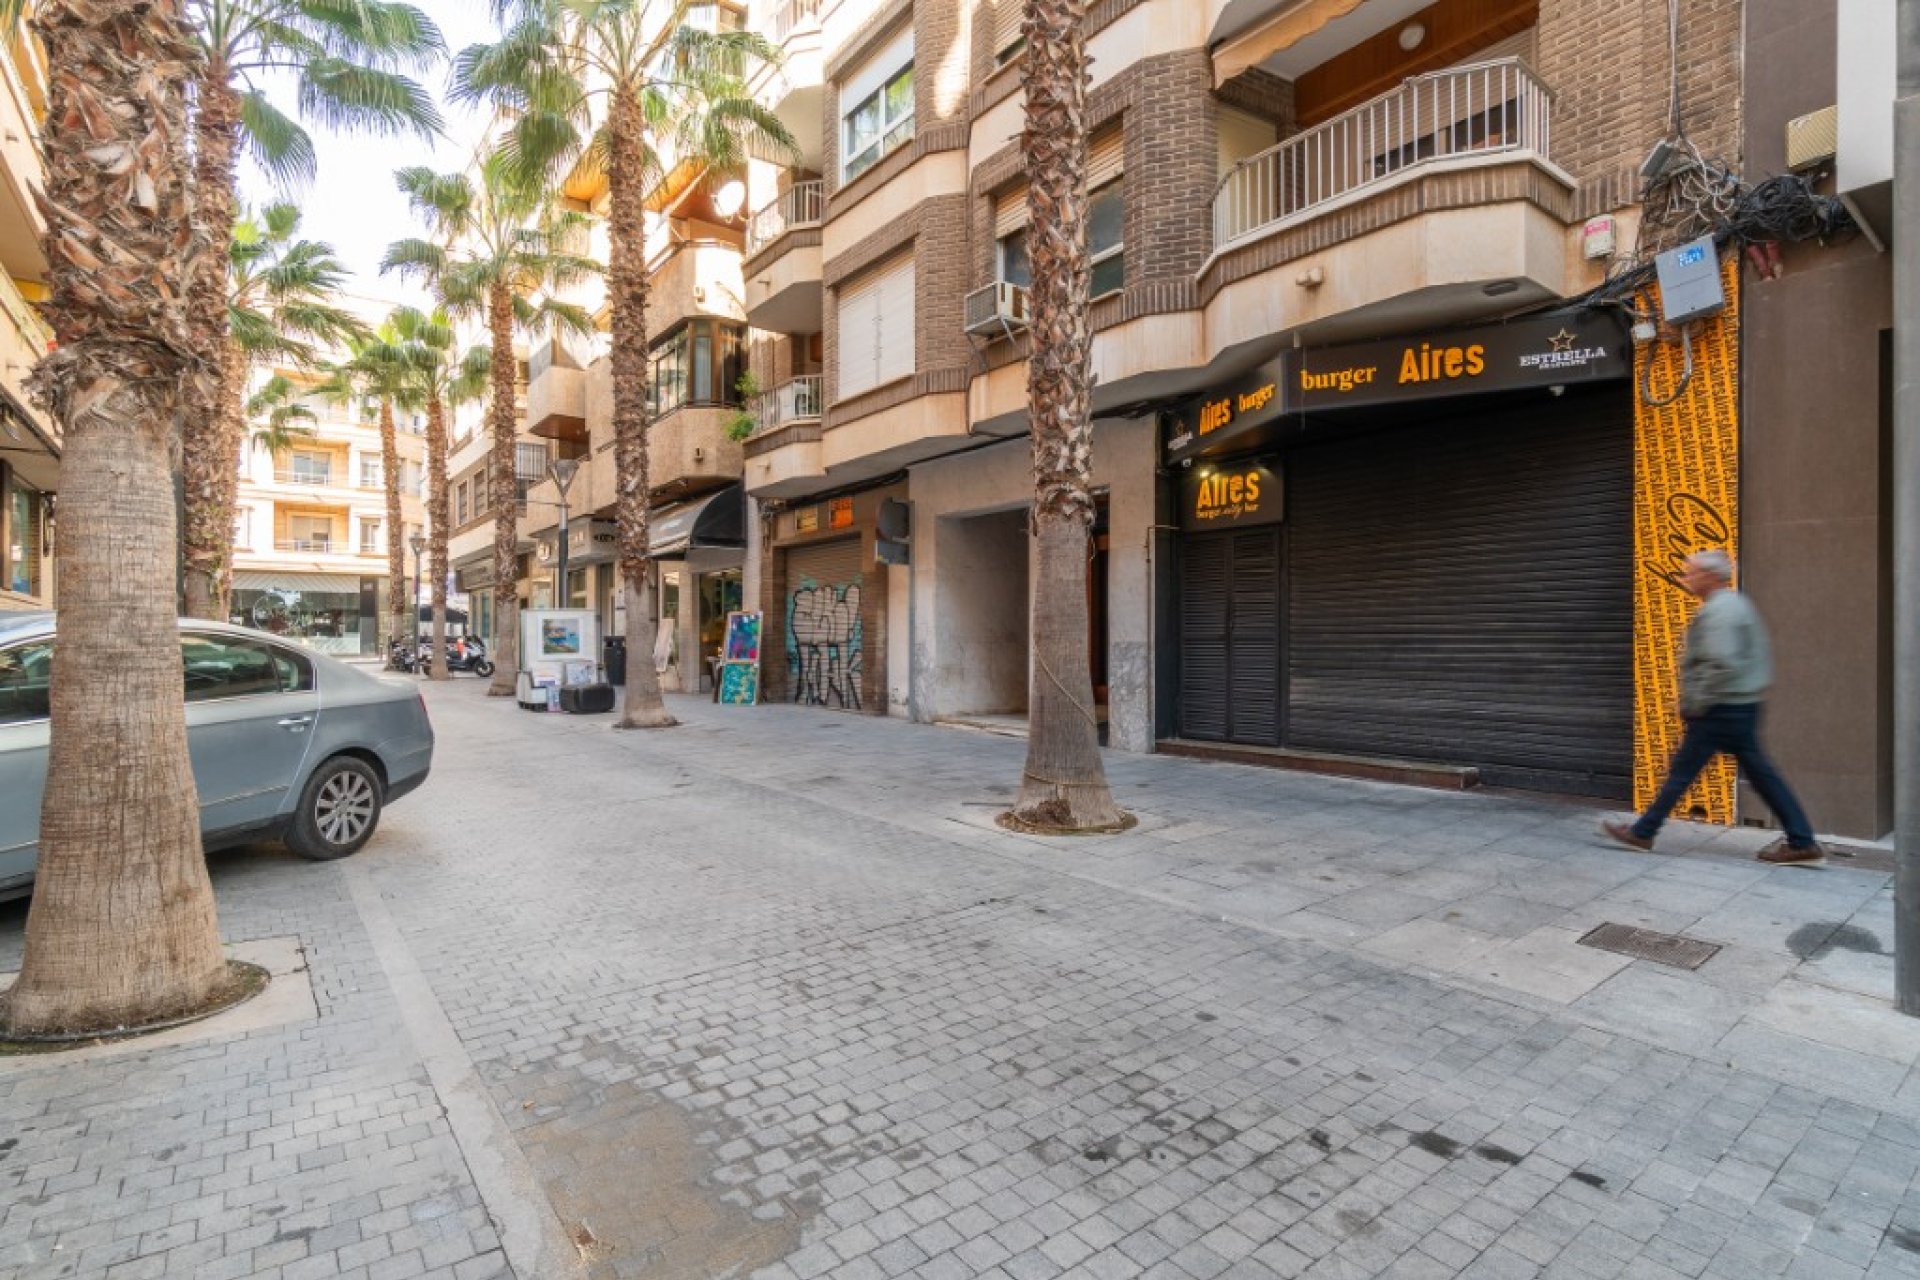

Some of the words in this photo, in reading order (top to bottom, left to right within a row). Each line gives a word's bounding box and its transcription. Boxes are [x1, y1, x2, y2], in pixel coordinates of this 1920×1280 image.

[1300, 366, 1376, 391] burger
[1399, 342, 1485, 384] Aires
[1199, 398, 1231, 436] Aires
[1239, 385, 1275, 412] burger
[1196, 471, 1260, 508] Aires
